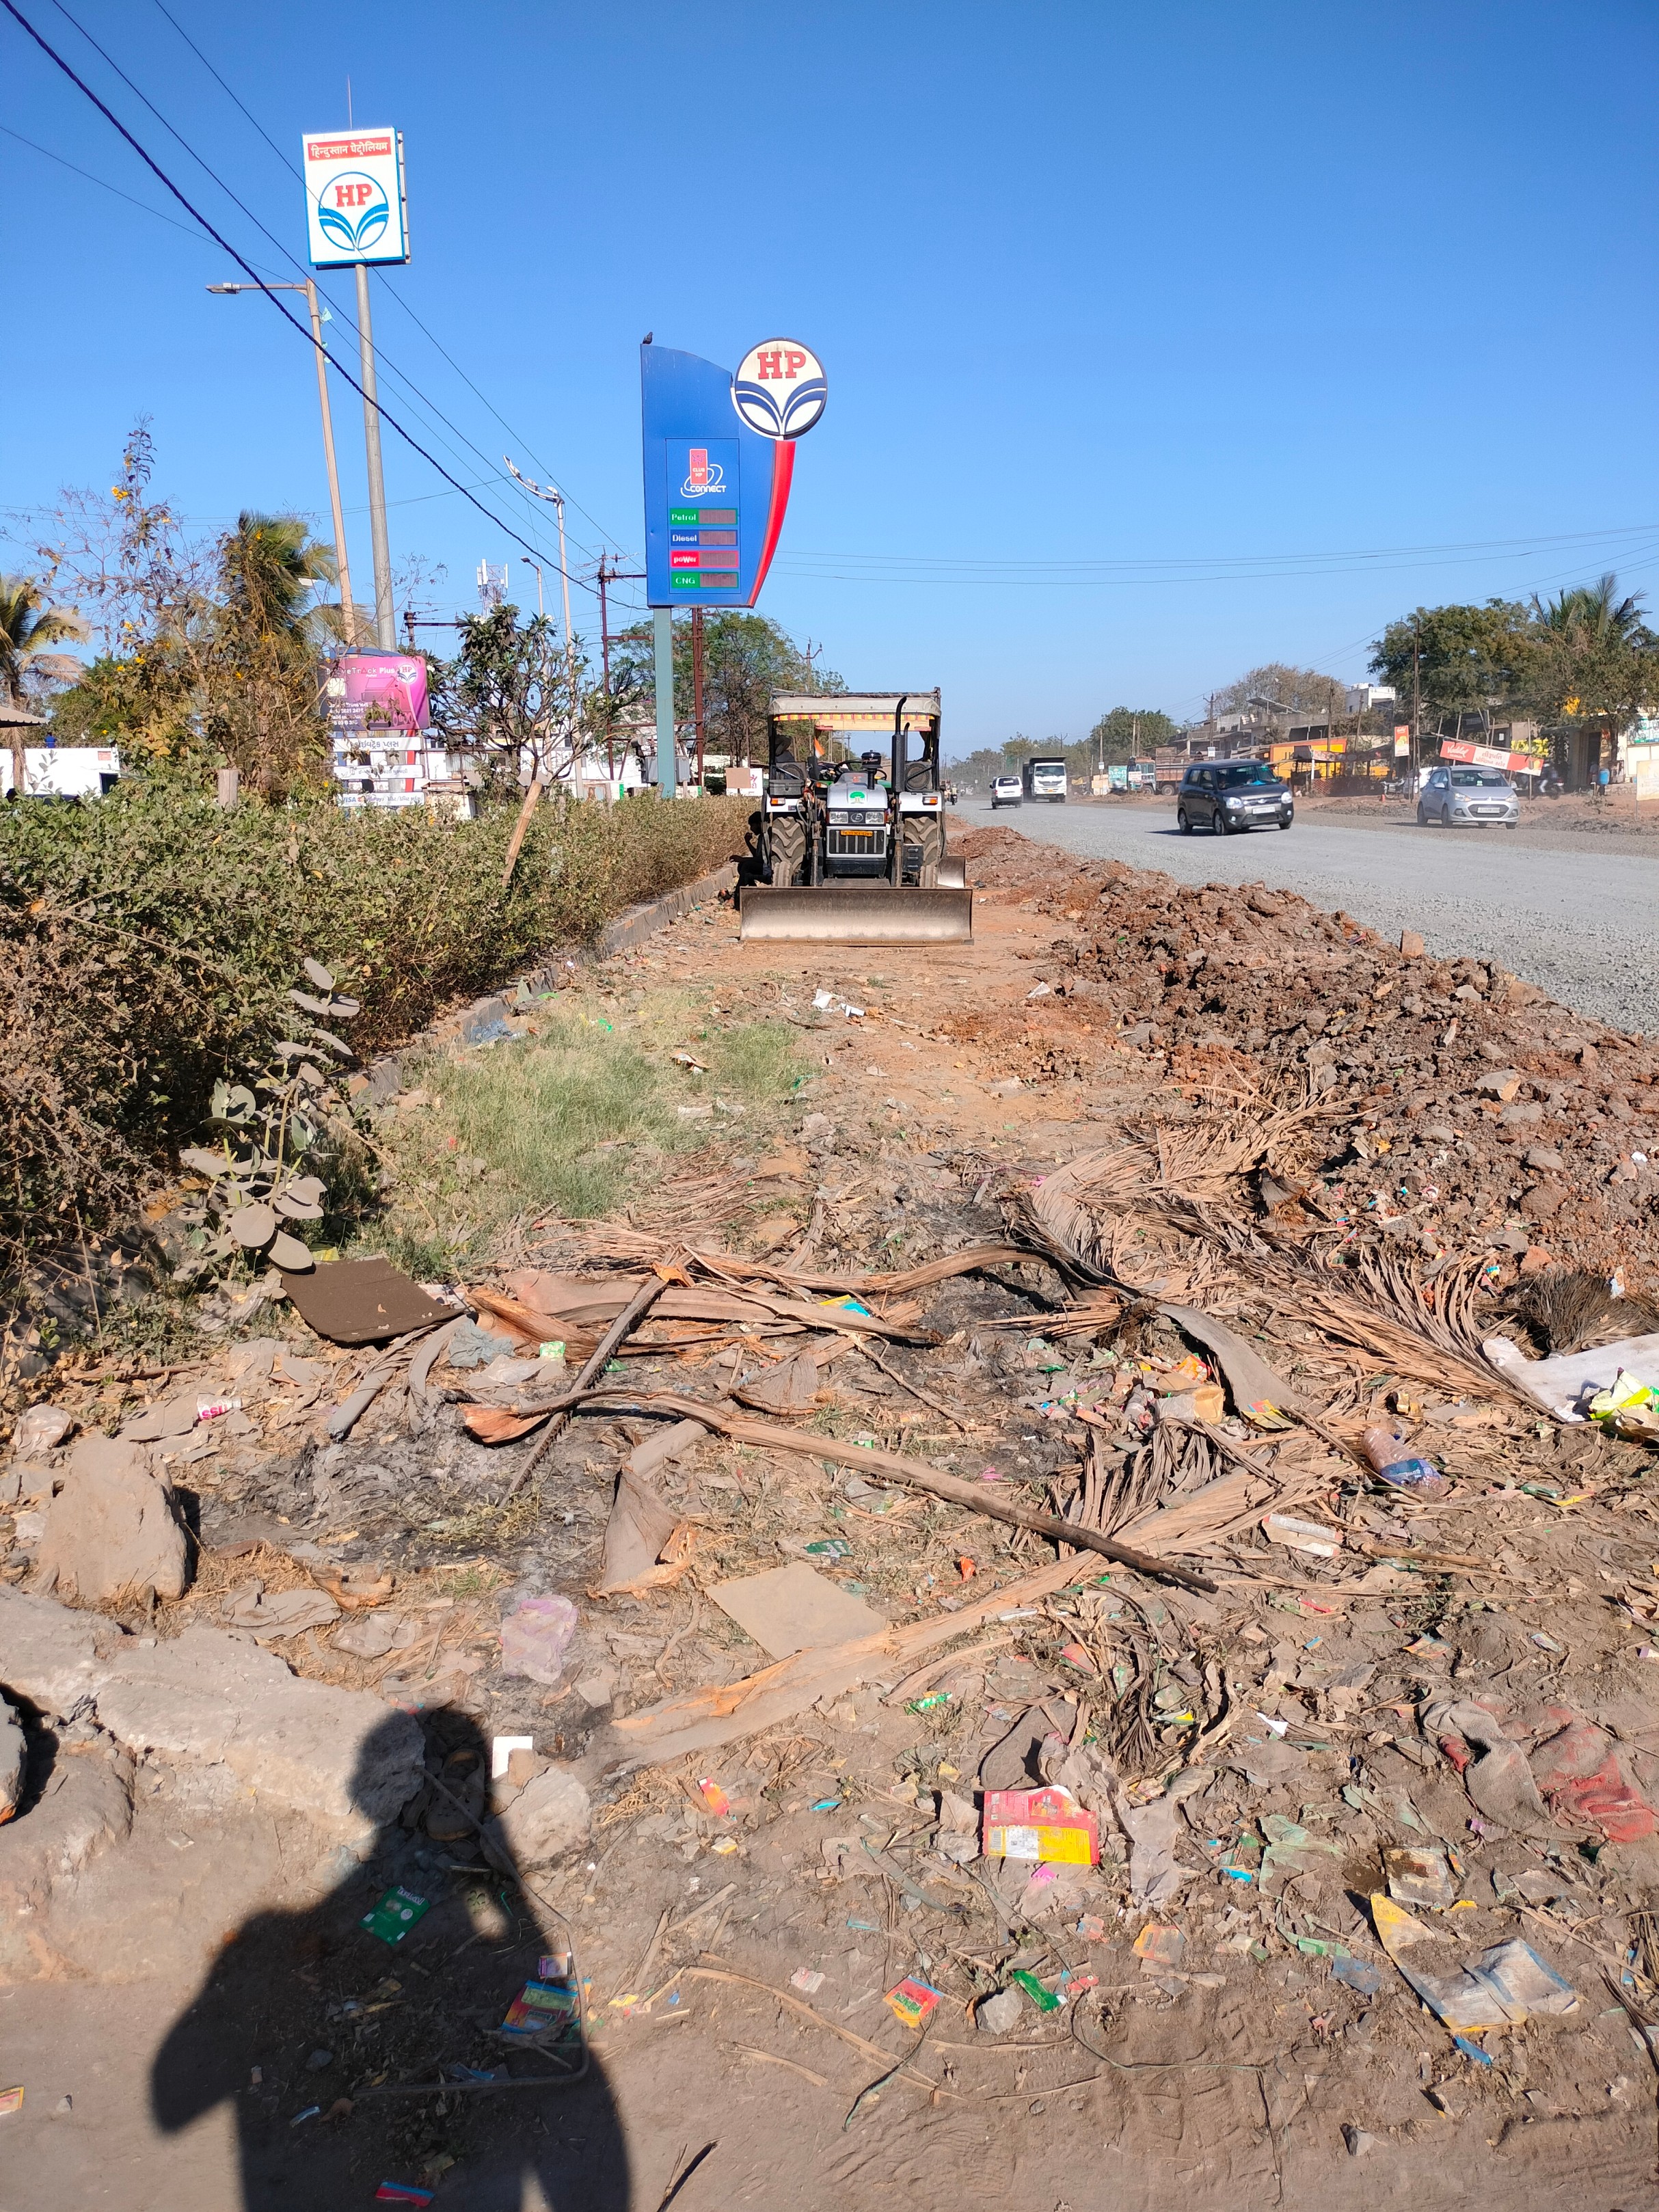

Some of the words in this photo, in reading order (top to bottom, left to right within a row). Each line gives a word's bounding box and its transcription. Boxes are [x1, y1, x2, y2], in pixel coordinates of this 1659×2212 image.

[311, 145, 349, 158] हिन्दुस्तान
[350, 141, 388, 156] पेट्रोलियम
[335, 183, 373, 207] HP
[757, 351, 807, 379] HP
